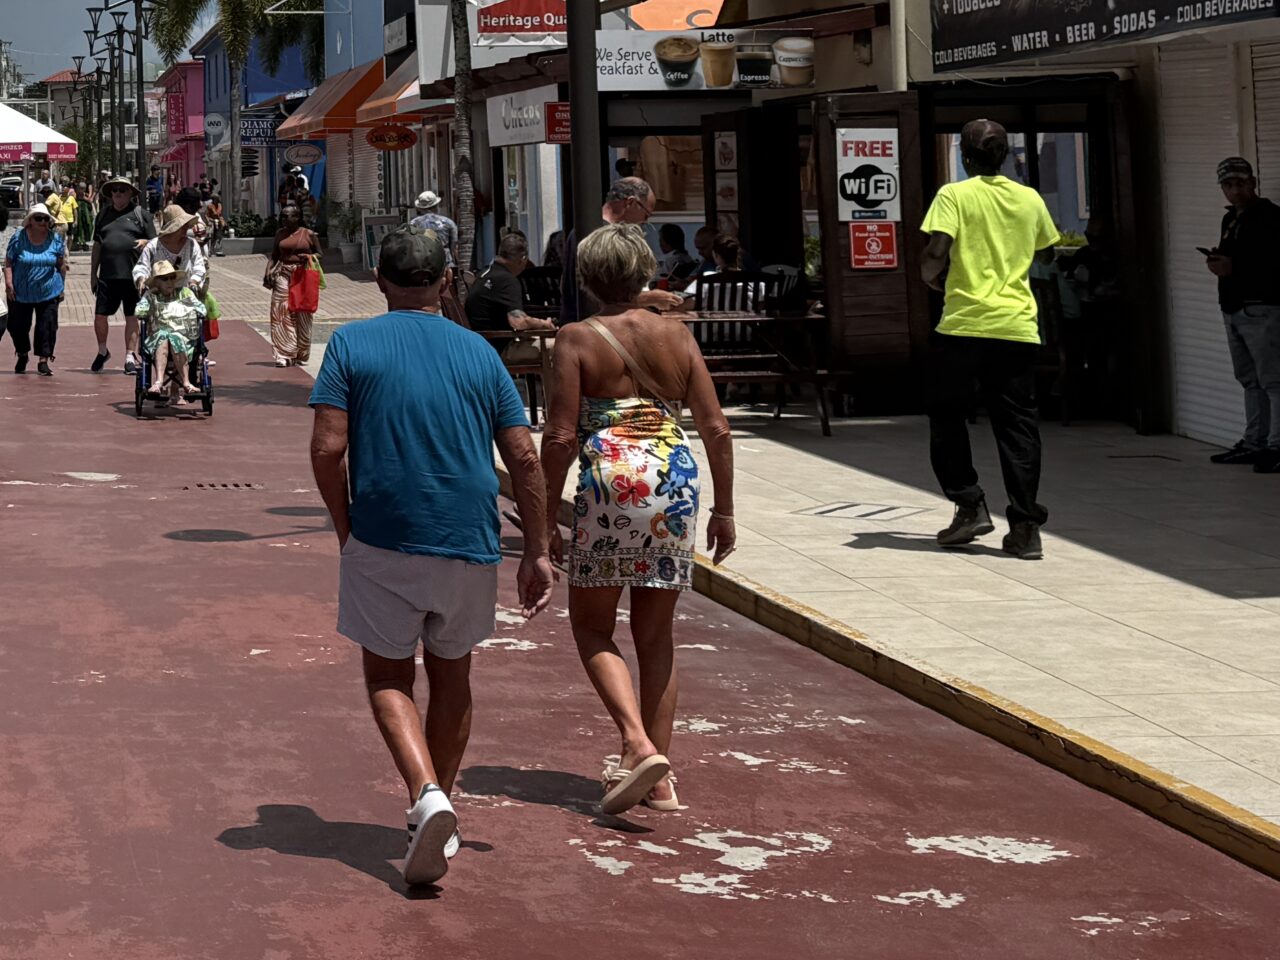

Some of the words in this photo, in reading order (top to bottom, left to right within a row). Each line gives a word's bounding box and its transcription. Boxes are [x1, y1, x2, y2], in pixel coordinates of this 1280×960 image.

[480, 14, 541, 29] Heritage
[701, 32, 735, 43] Latte
[935, 49, 953, 65] COLD
[953, 42, 997, 61] BEVERAGES
[1012, 30, 1049, 52] WATER
[1066, 22, 1096, 44] BEER
[1113, 9, 1156, 34] SODAS
[1176, 3, 1203, 23] COLD
[615, 48, 652, 62] Serve
[648, 61, 659, 75] &
[666, 72, 688, 80] Coffee
[740, 73, 770, 82] Espresso
[842, 140, 893, 157] FREE
[843, 178, 891, 195] WiFi
